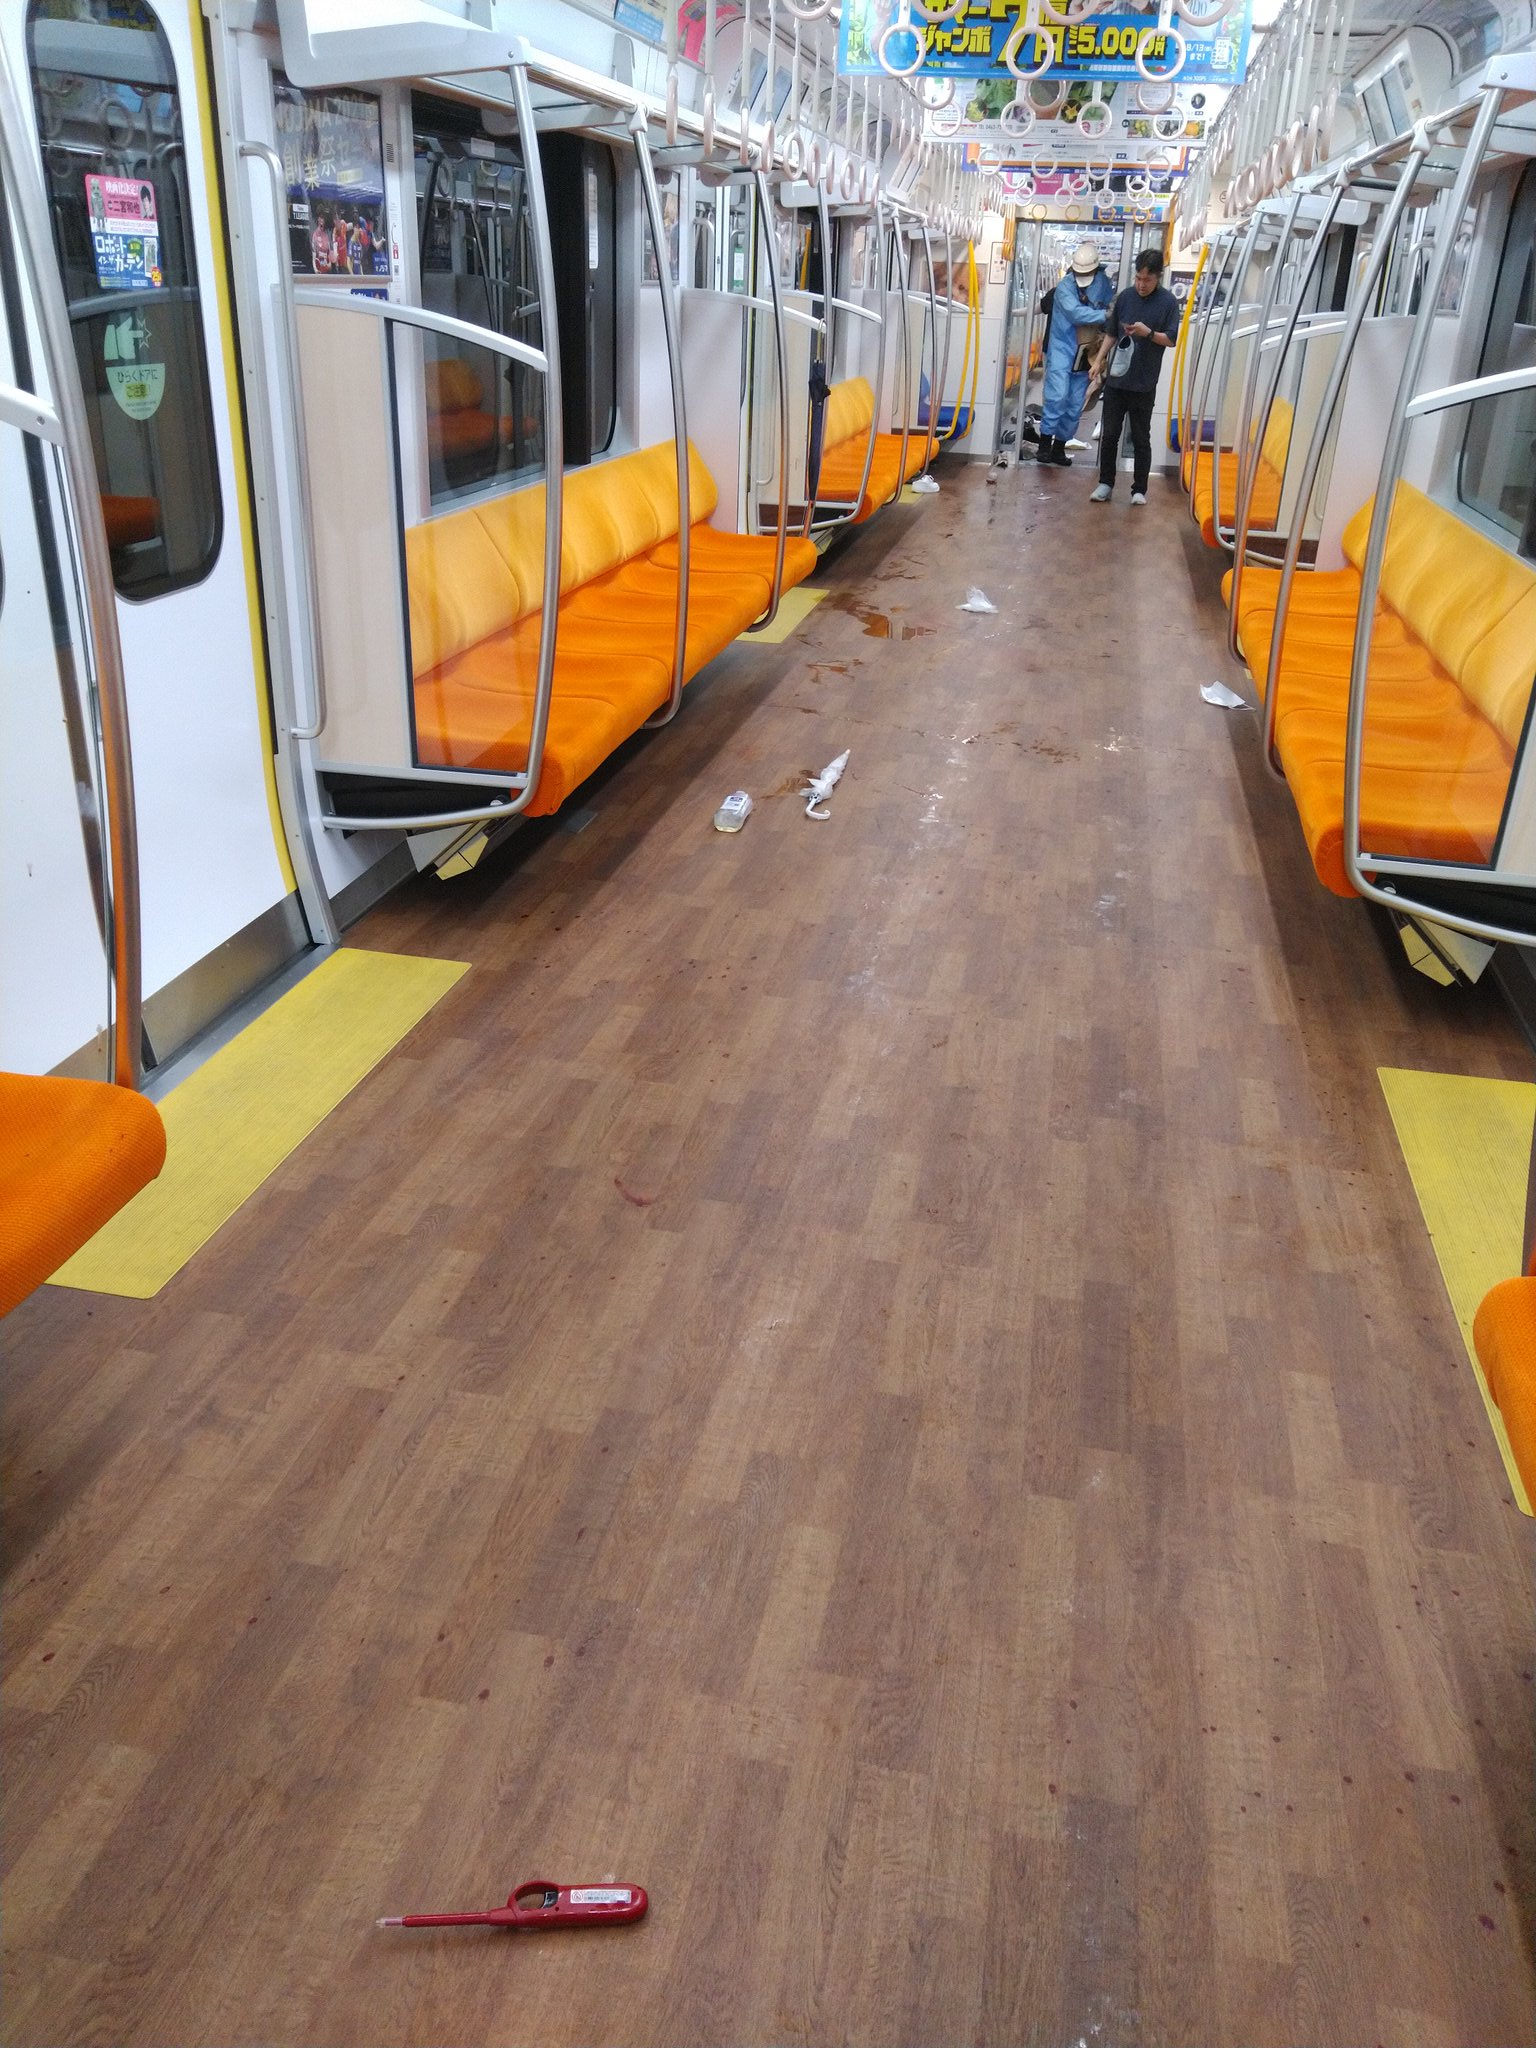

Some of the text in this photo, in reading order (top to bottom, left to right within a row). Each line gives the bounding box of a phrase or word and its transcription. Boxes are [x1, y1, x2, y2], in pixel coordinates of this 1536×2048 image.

[916, 26, 992, 53] ジャンボ
[95, 234, 127, 254] ロボット
[115, 253, 144, 273] ガーデン
[117, 368, 158, 384] ひらくドアに
